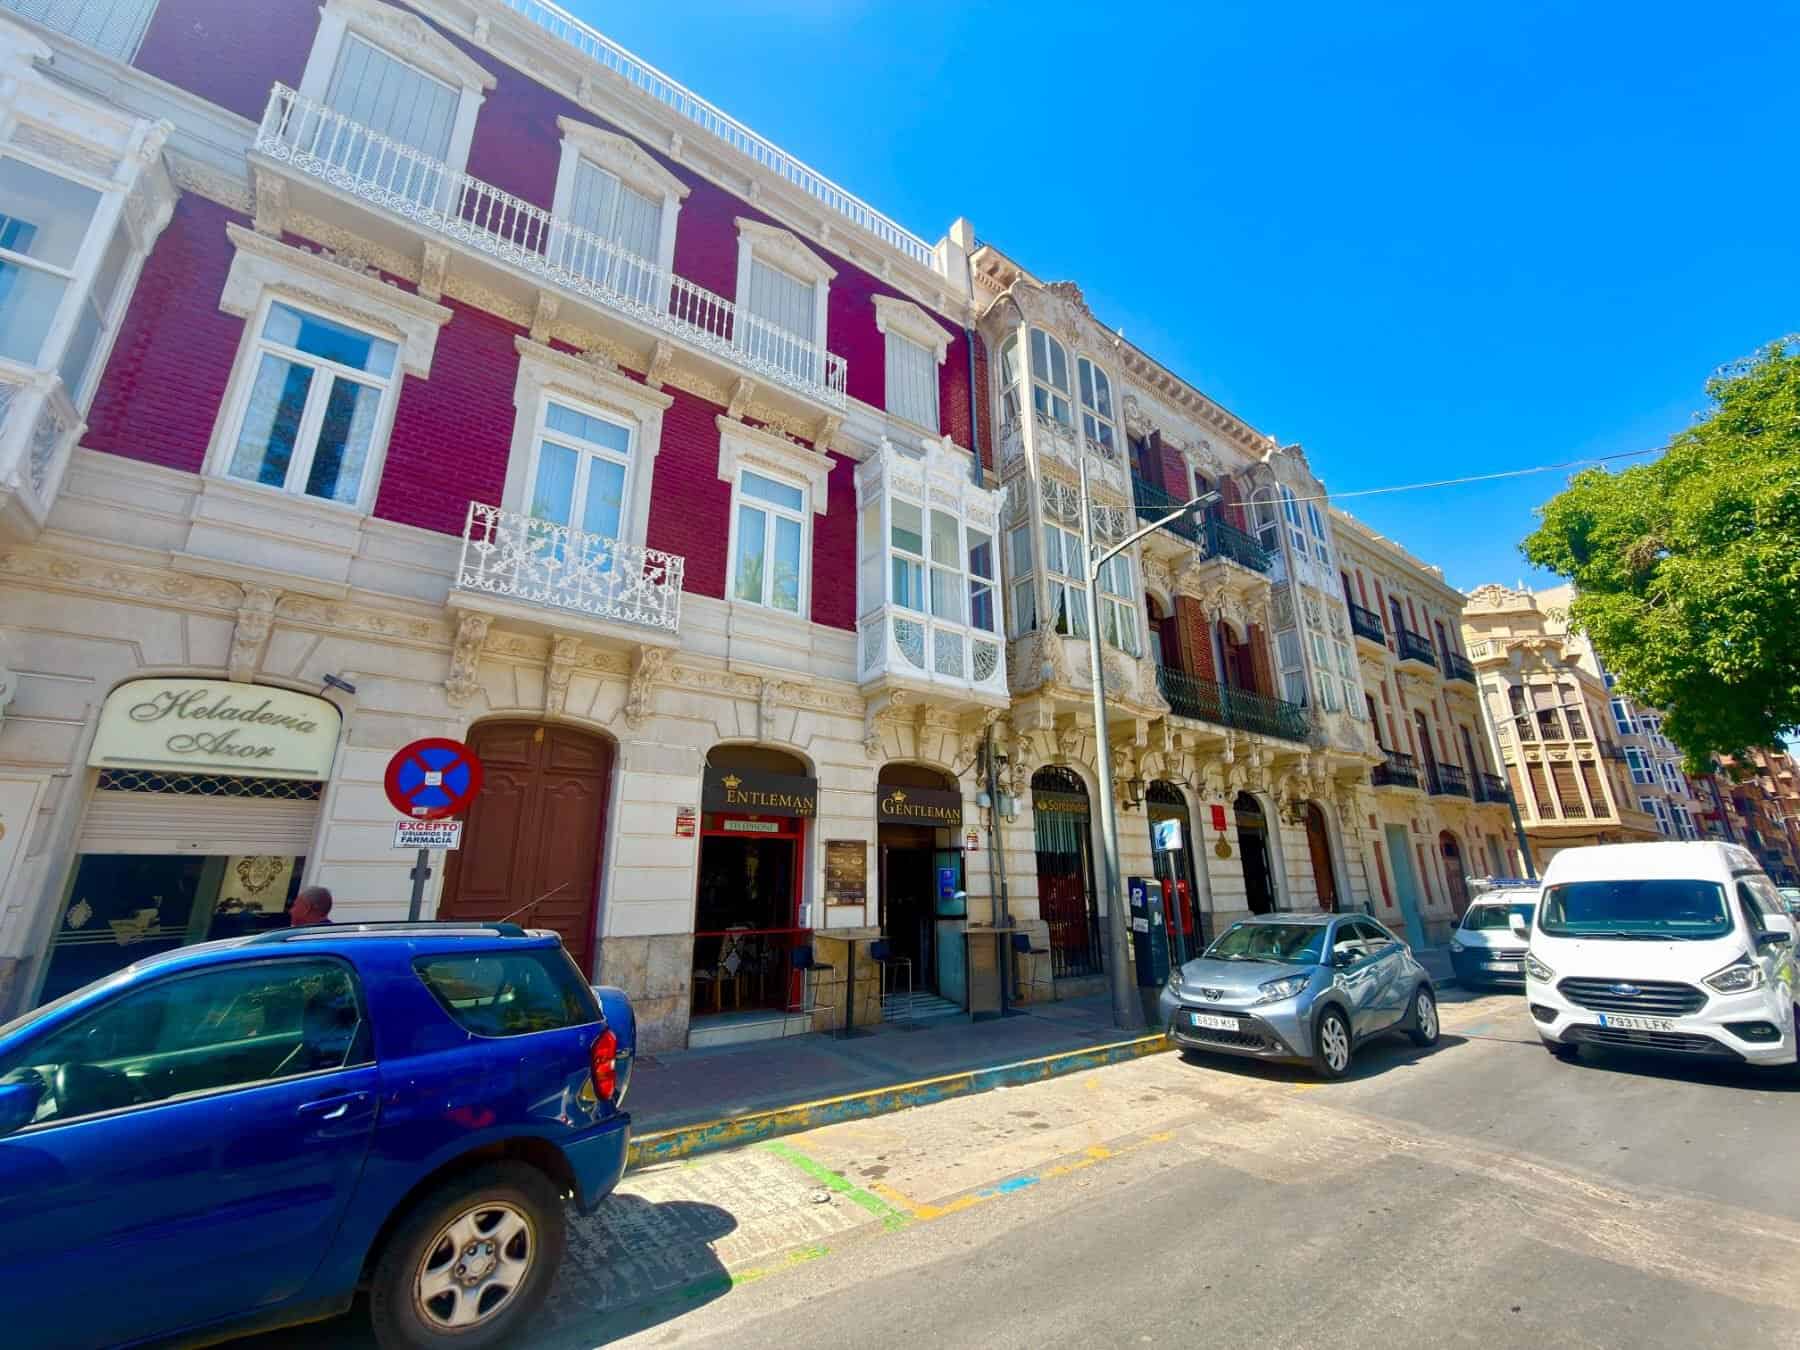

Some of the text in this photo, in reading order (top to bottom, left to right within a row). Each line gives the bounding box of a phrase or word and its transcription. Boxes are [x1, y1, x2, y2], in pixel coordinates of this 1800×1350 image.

[166, 728, 275, 759] Azor
[882, 798, 960, 819] GENTLEMAN
[399, 822, 458, 832] EXCEPTO
[400, 836, 452, 844] FARMACIA
